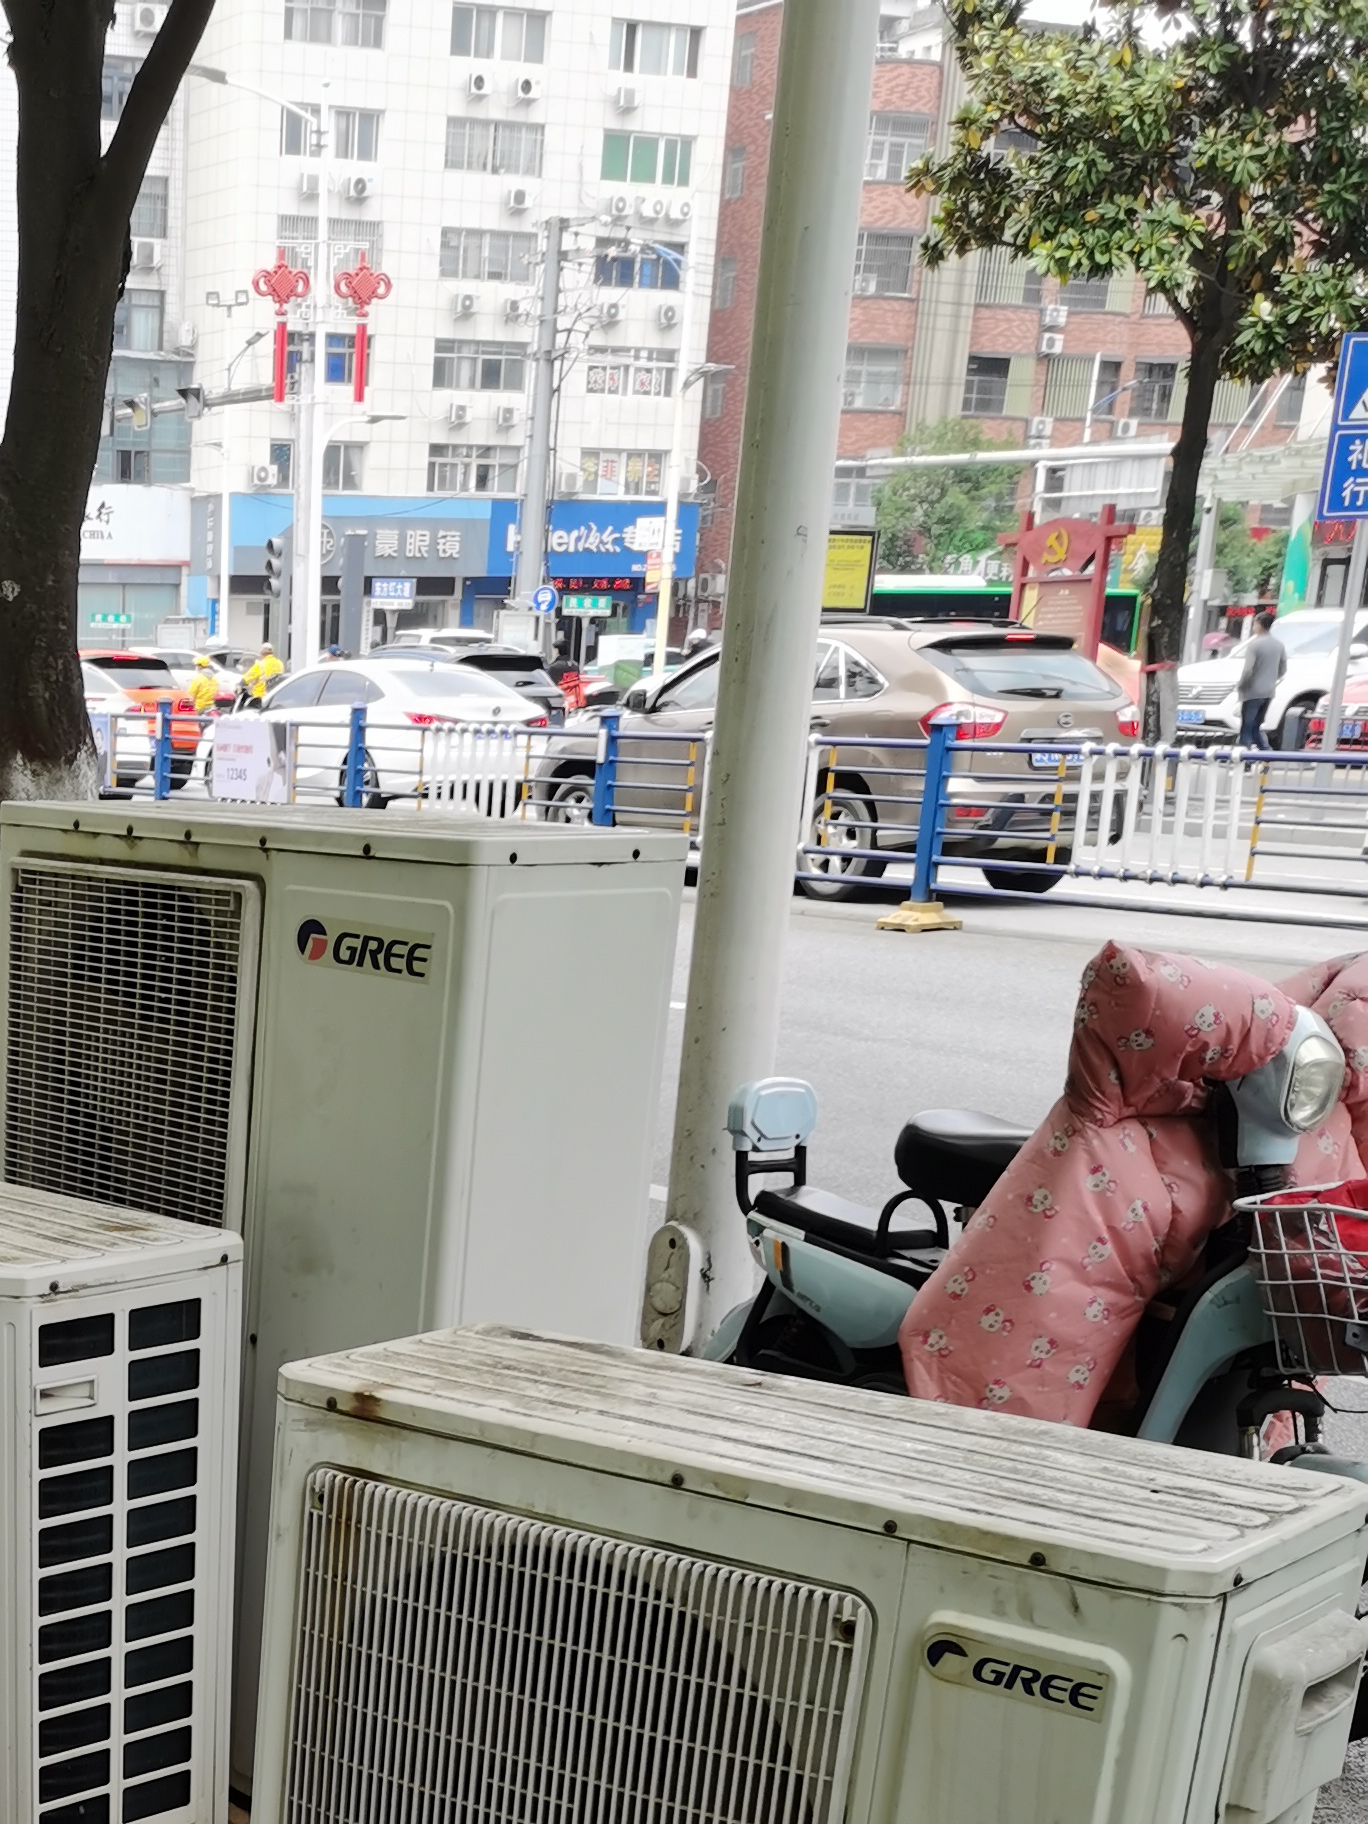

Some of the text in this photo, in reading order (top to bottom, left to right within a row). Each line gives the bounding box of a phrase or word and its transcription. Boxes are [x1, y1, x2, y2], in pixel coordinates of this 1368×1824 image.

[226, 767, 247, 782] 12345
[332, 932, 432, 978] GREE
[972, 1657, 1104, 1712] GREE
